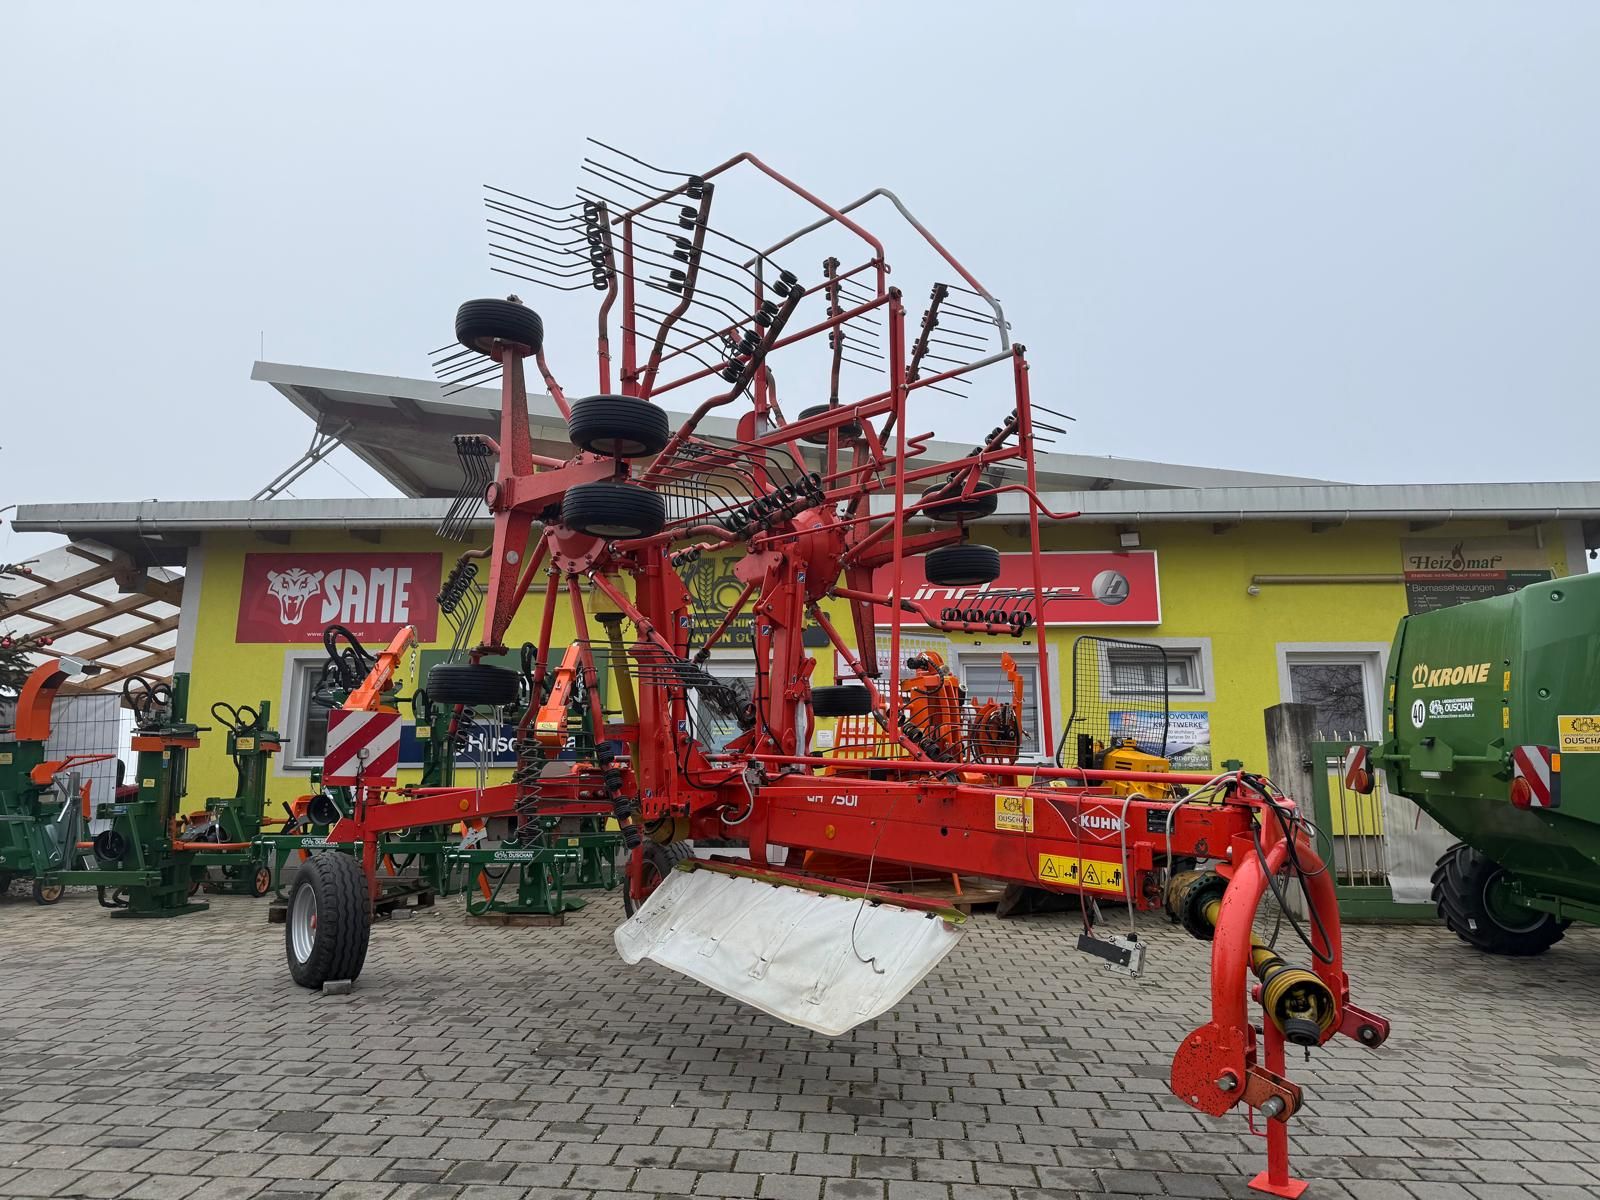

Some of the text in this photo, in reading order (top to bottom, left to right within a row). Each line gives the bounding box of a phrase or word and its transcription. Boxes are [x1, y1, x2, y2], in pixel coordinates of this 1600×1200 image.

[1409, 554, 1502, 572] Heizomat
[320, 567, 413, 624] SAME
[1412, 584, 1495, 593] Biomasseheizungen
[1427, 663, 1491, 687] KRONE
[1413, 704, 1424, 723] 40
[1444, 702, 1473, 712] OUSCHAN
[1080, 815, 1121, 831] KUHN
